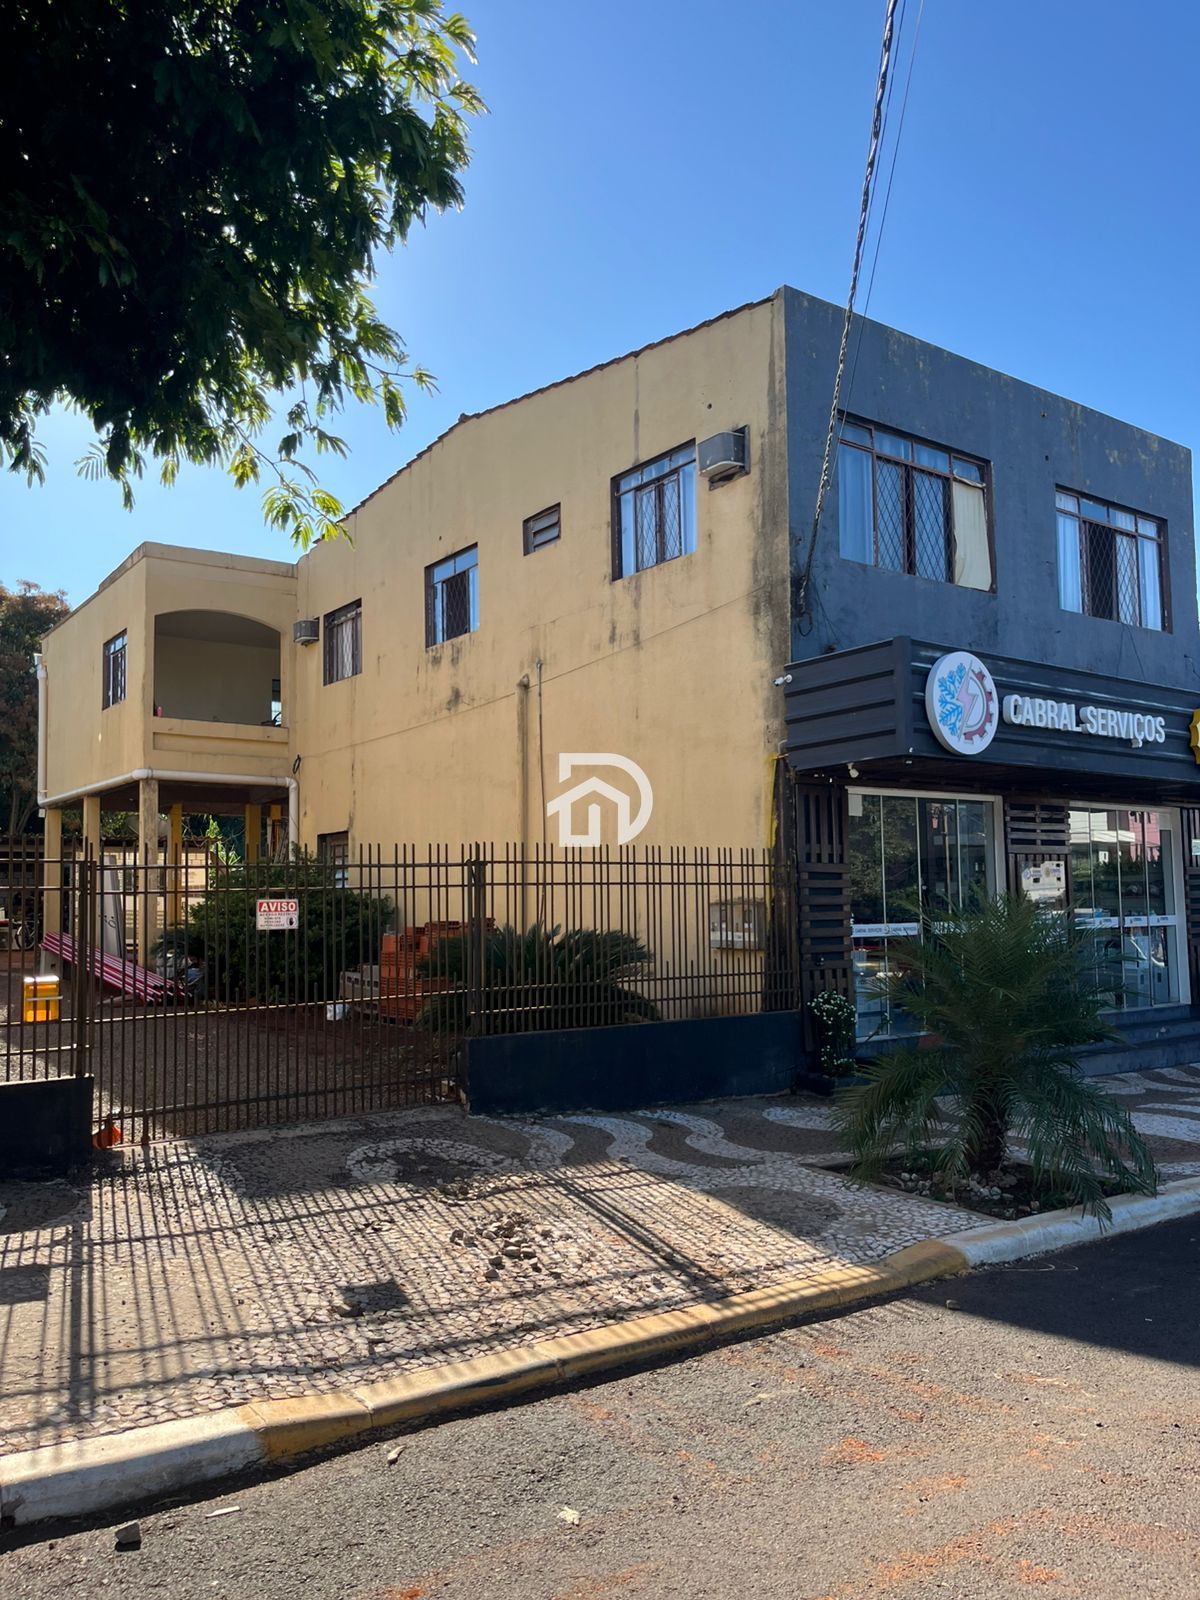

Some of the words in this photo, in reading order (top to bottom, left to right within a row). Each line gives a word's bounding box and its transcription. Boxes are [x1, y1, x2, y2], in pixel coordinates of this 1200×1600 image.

[1004, 695, 1082, 731] CABRAL
[1081, 706, 1166, 748] SERVIÇOS
[260, 902, 296, 912] AVISO
